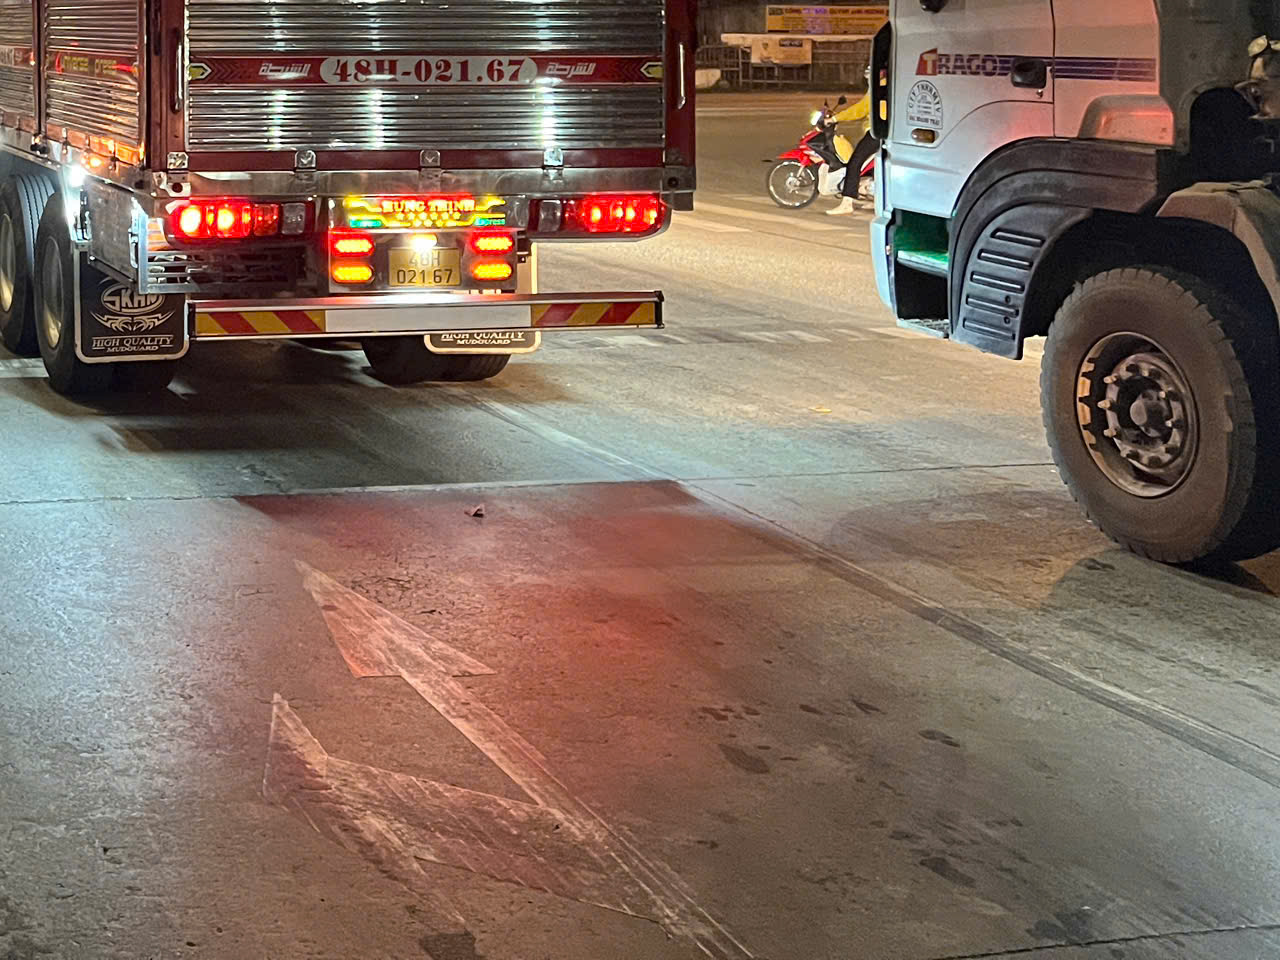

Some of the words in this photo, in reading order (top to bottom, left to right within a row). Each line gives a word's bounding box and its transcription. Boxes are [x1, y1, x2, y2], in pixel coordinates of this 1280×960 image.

[332, 57, 526, 84] 48H-021.67
[918, 50, 998, 77] TRAGO
[396, 267, 453, 284] 021.67
[92, 338, 120, 348] HIGH
[123, 336, 173, 347] QUALITY
[473, 331, 525, 339] QUALITY
[106, 345, 159, 353] MUDGUARD
